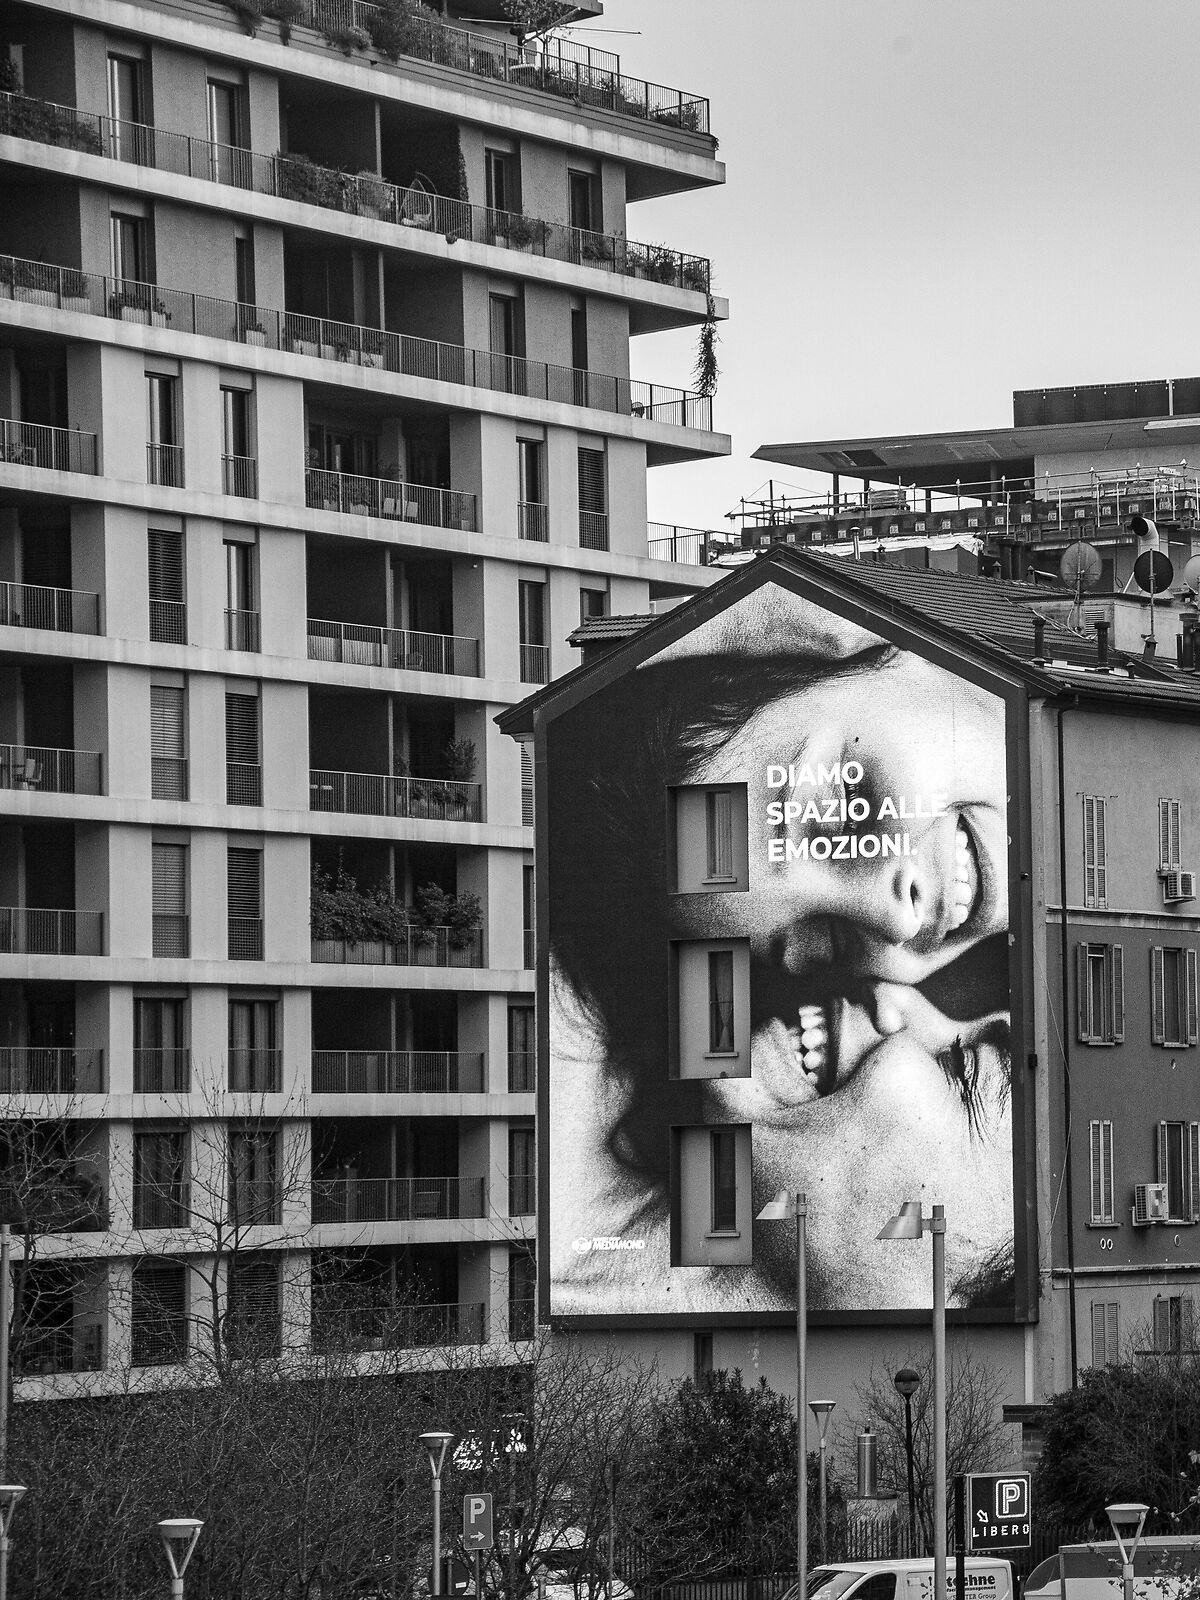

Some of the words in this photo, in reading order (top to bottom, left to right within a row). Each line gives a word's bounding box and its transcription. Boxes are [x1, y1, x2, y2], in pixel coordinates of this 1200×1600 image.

[766, 761, 864, 788] DIAMO
[766, 797, 870, 826] SPAZIO
[877, 794, 948, 820] ALLE
[767, 833, 918, 862] EMOZIONI.
[471, 1498, 486, 1524] P
[1003, 1484, 1020, 1514] P
[972, 1524, 1030, 1537] LIBERO
[978, 1592, 997, 1600] Group
